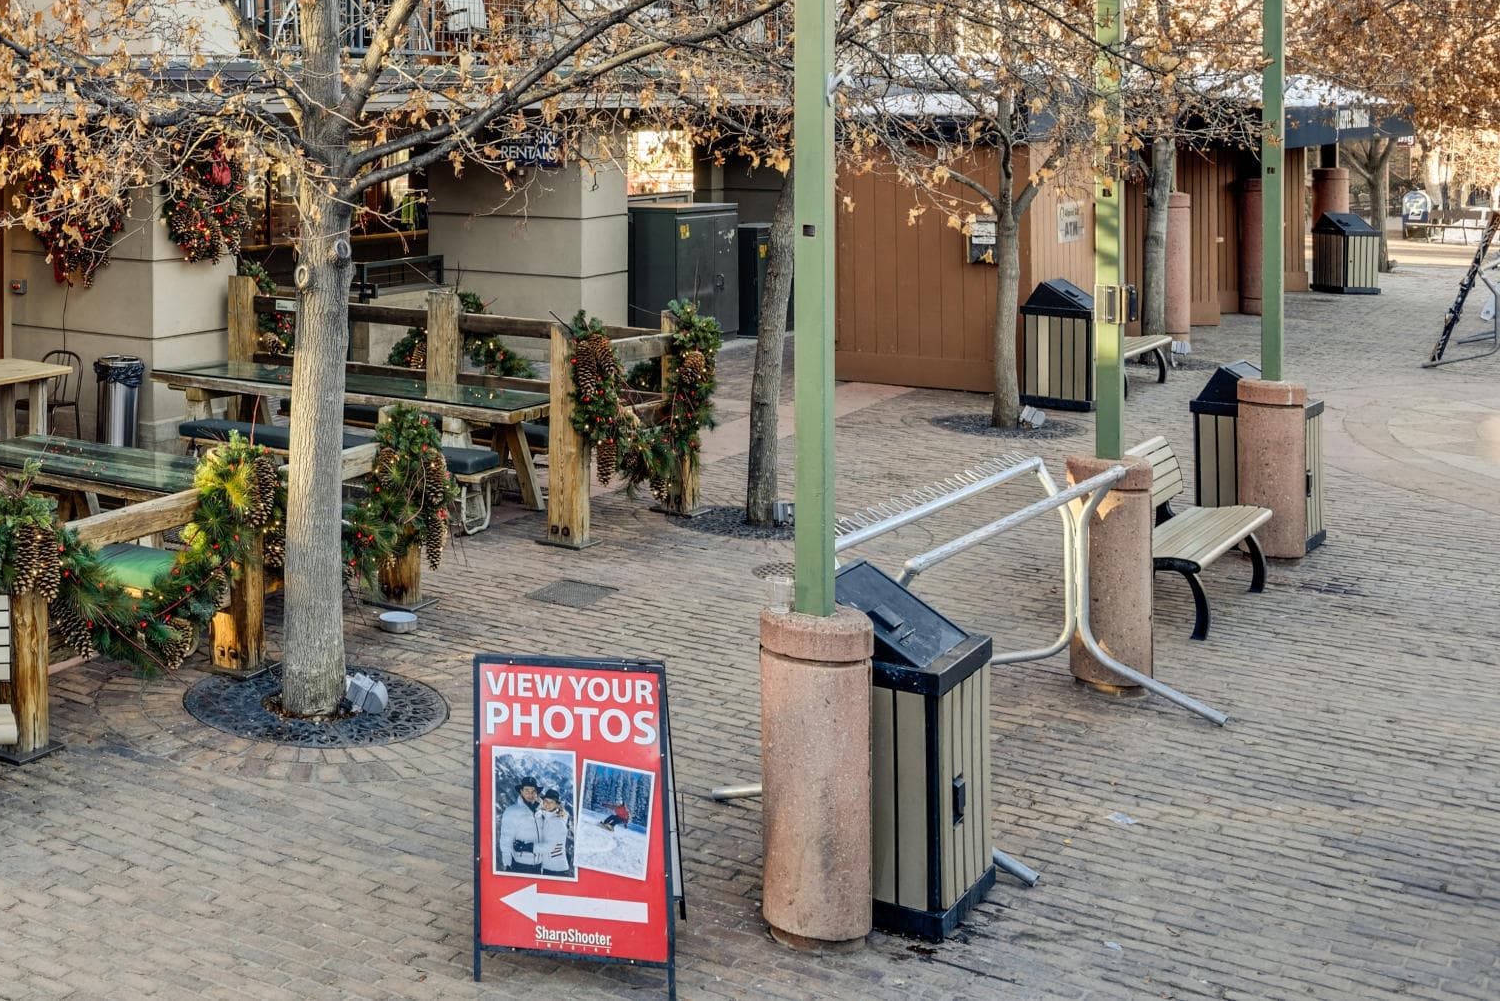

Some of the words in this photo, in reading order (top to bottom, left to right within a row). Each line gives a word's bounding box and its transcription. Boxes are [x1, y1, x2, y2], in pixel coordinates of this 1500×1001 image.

[500, 145, 557, 160] RENTALS
[486, 671, 563, 699] VIEW
[568, 675, 654, 705] YOUR
[485, 701, 657, 745] PHOTOS
[535, 925, 612, 946] SharpShooter
